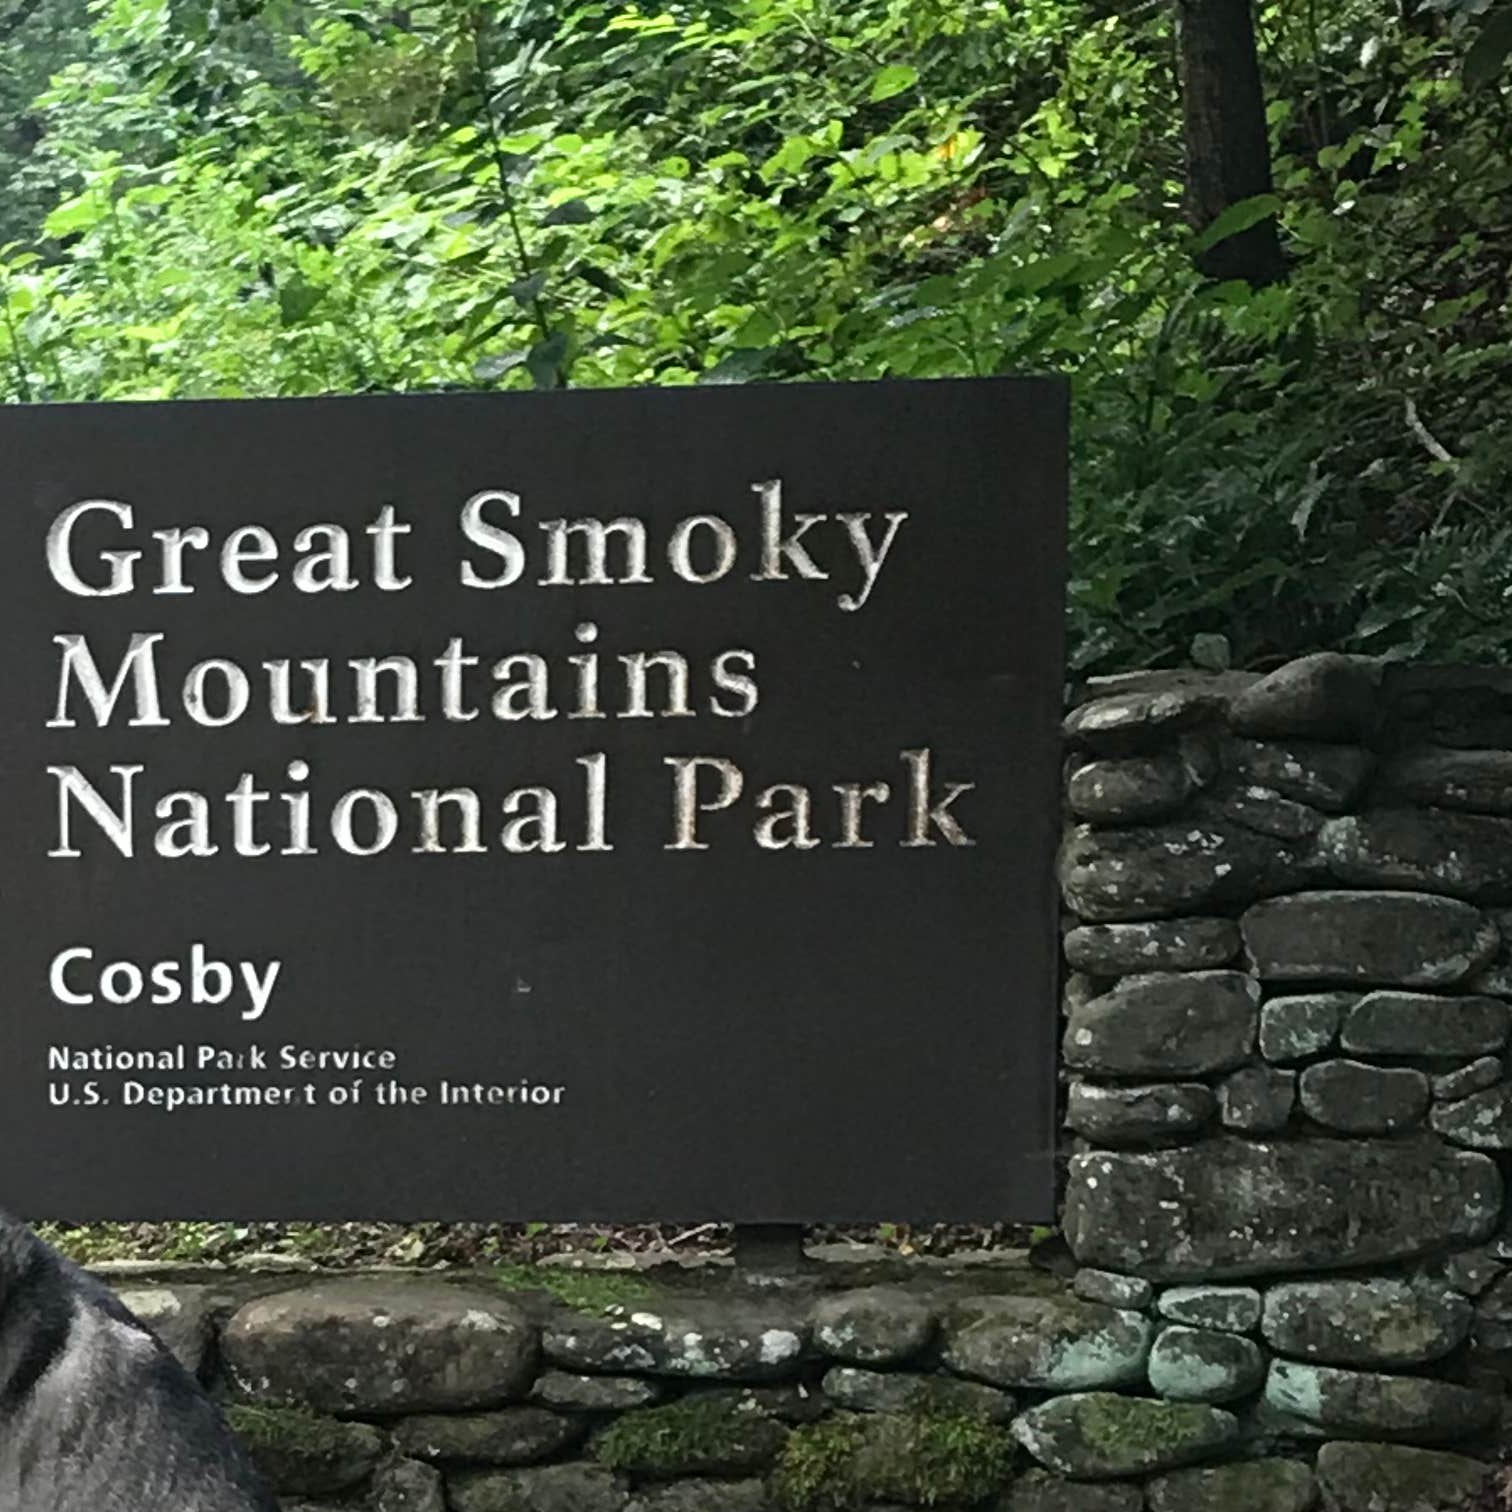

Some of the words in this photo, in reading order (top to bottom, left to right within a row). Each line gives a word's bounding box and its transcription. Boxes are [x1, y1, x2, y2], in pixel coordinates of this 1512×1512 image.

[46, 499, 413, 597] Great
[460, 479, 909, 612] Smoky
[45, 622, 759, 728] Mountains
[46, 752, 614, 858] National
[662, 748, 976, 850] Park
[49, 943, 281, 1021] Cosby
[48, 1044, 185, 1071] National
[197, 1044, 267, 1070] Park
[279, 1044, 396, 1070] Service
[49, 1081, 109, 1106] U.S.
[328, 1078, 363, 1105] of
[375, 1078, 428, 1105] the
[440, 1078, 566, 1105] Interior
